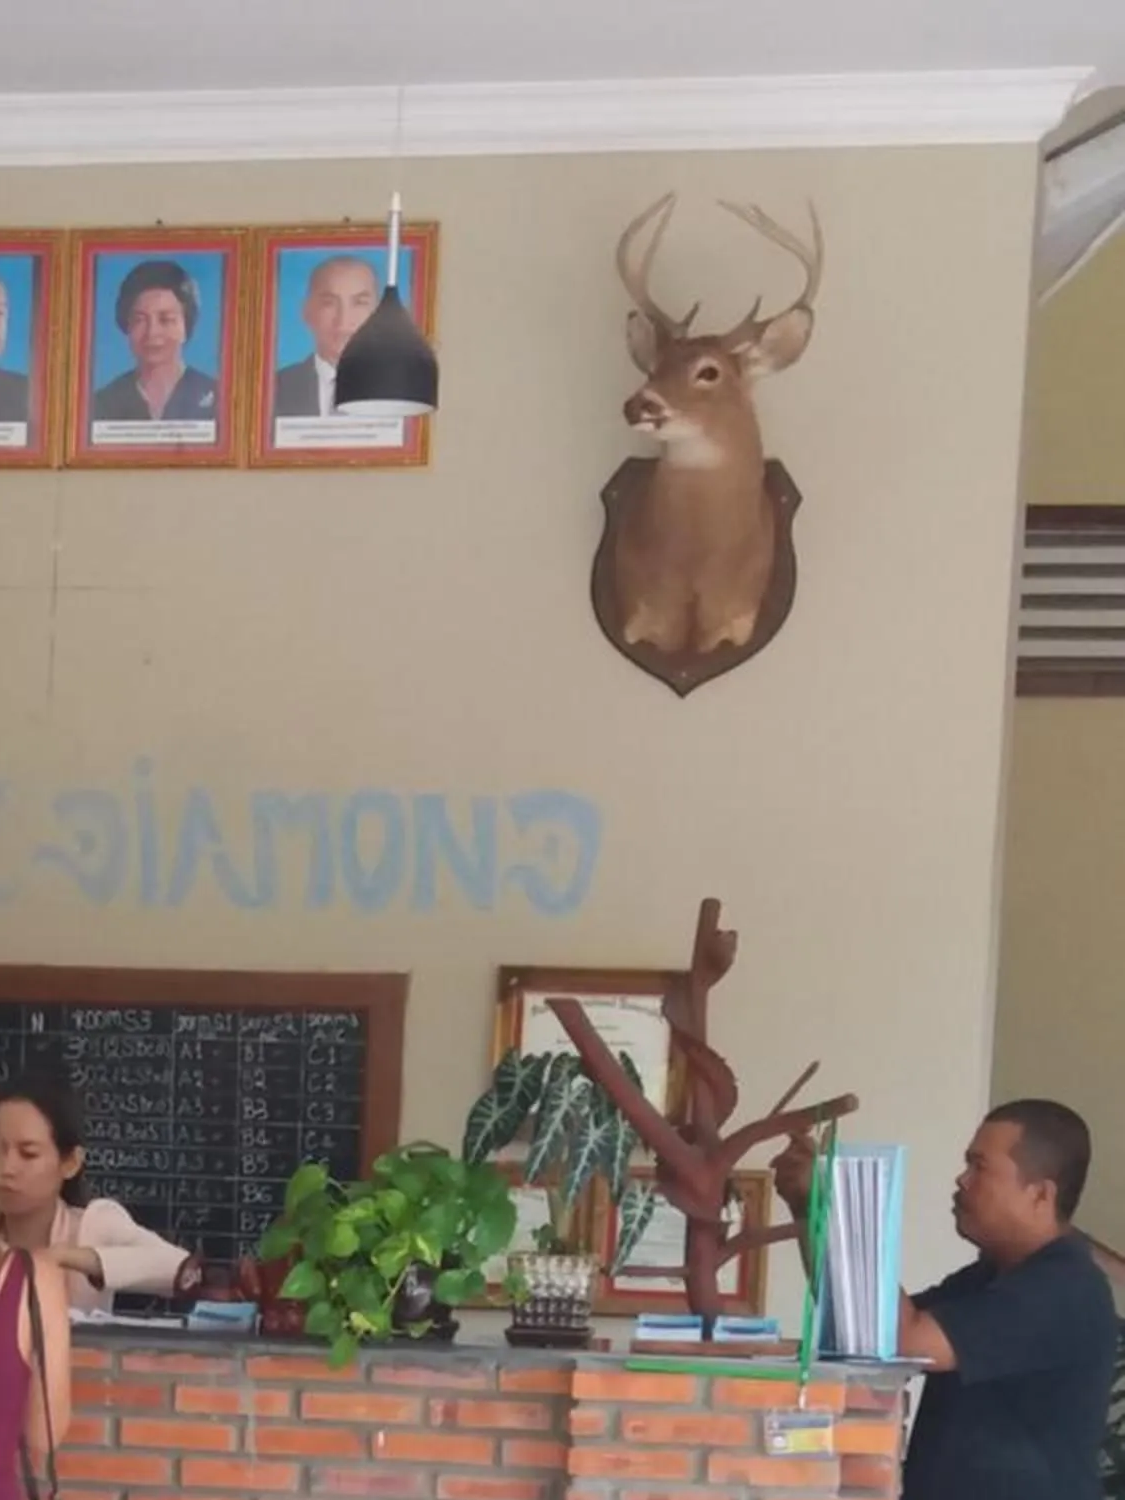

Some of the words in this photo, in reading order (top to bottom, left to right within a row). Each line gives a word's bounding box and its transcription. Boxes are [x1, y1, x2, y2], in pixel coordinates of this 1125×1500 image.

[179, 1040, 204, 1060] A1
[244, 1043, 265, 1063] B1
[308, 1044, 336, 1065] C1
[307, 1072, 336, 1095] C2
[242, 1097, 269, 1121] B3
[306, 1102, 336, 1122] C3
[241, 1127, 271, 1148] B4
[241, 1154, 269, 1175] B5
[241, 1183, 273, 1204] B6
